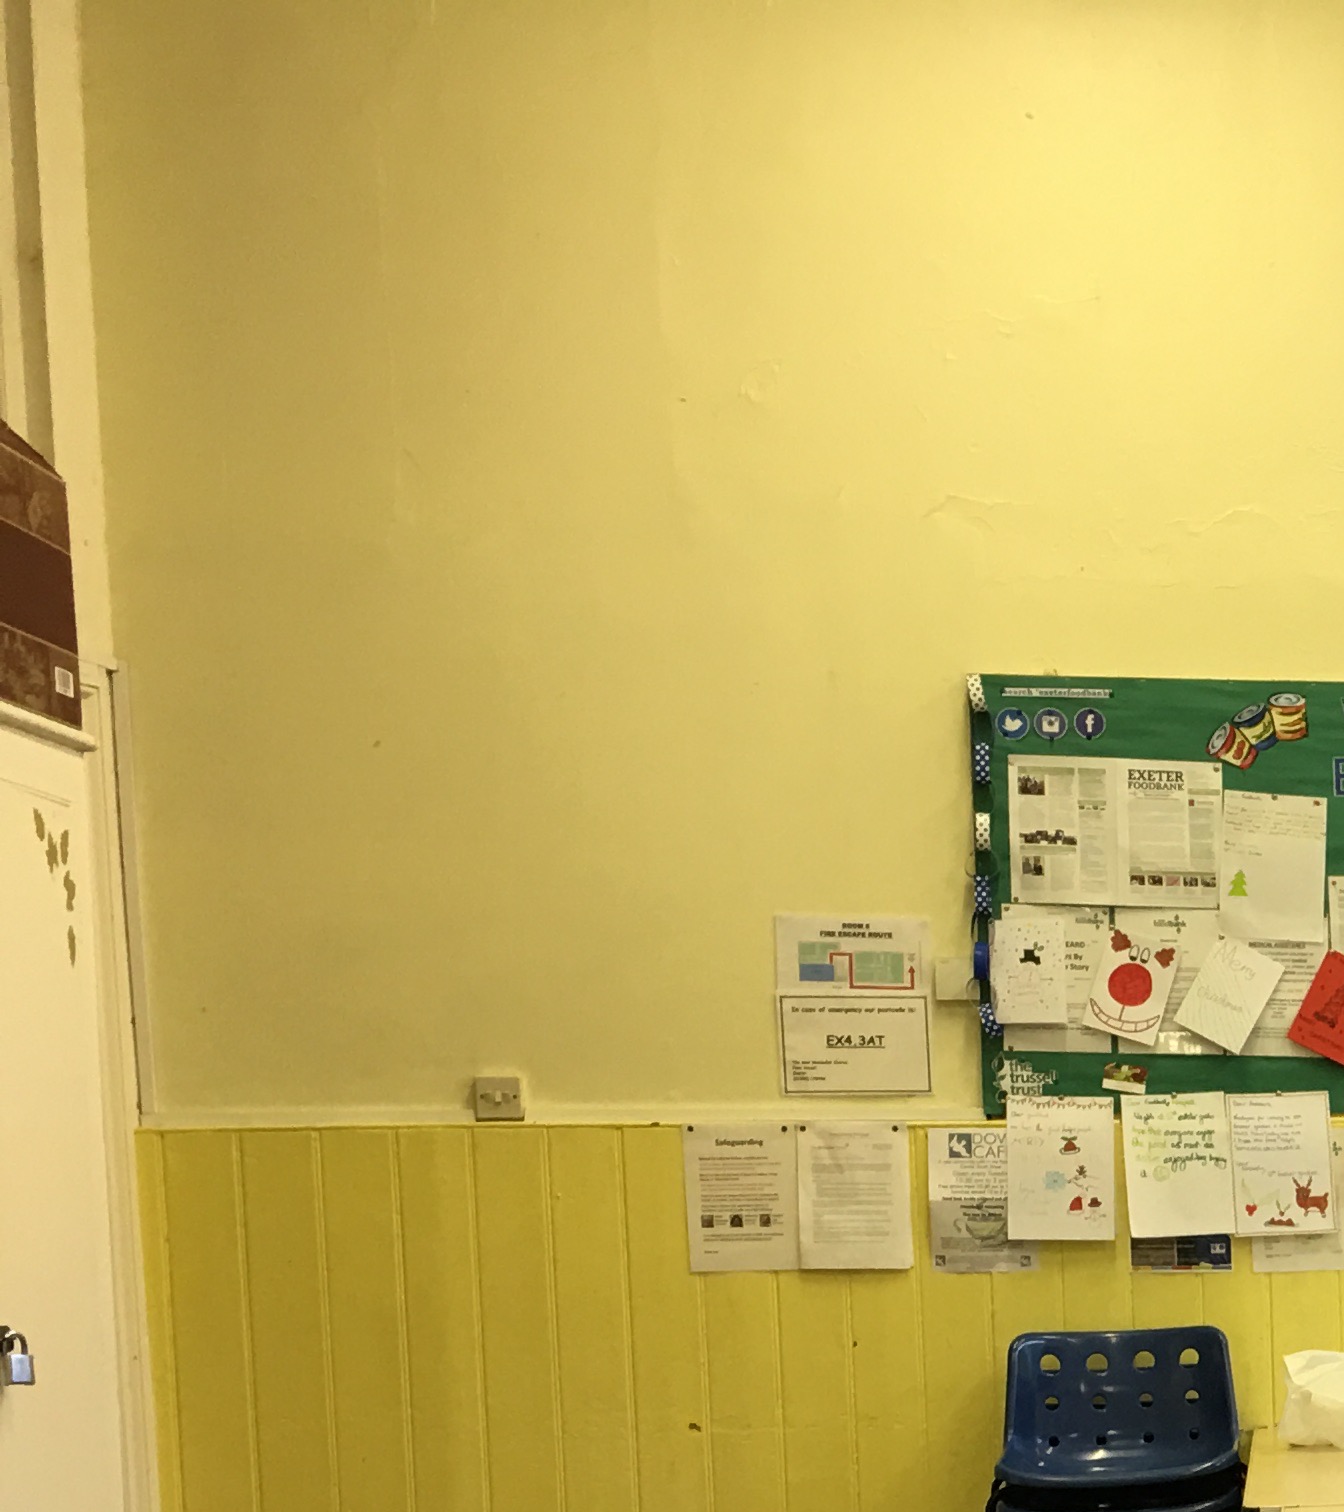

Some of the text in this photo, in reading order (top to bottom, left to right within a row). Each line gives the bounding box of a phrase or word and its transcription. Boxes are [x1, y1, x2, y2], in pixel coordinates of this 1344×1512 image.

[1127, 768, 1184, 782] EXETER
[1127, 781, 1185, 791] FOODBANK
[877, 1006, 905, 1014] postcode
[826, 1034, 885, 1046] EX4 3AT
[1009, 1059, 1032, 1072] the
[1010, 1084, 1042, 1096] trust
[715, 1138, 763, 1148] Safeguarding
[972, 1132, 1007, 1145] DOV
[973, 1145, 1007, 1158] CAF
